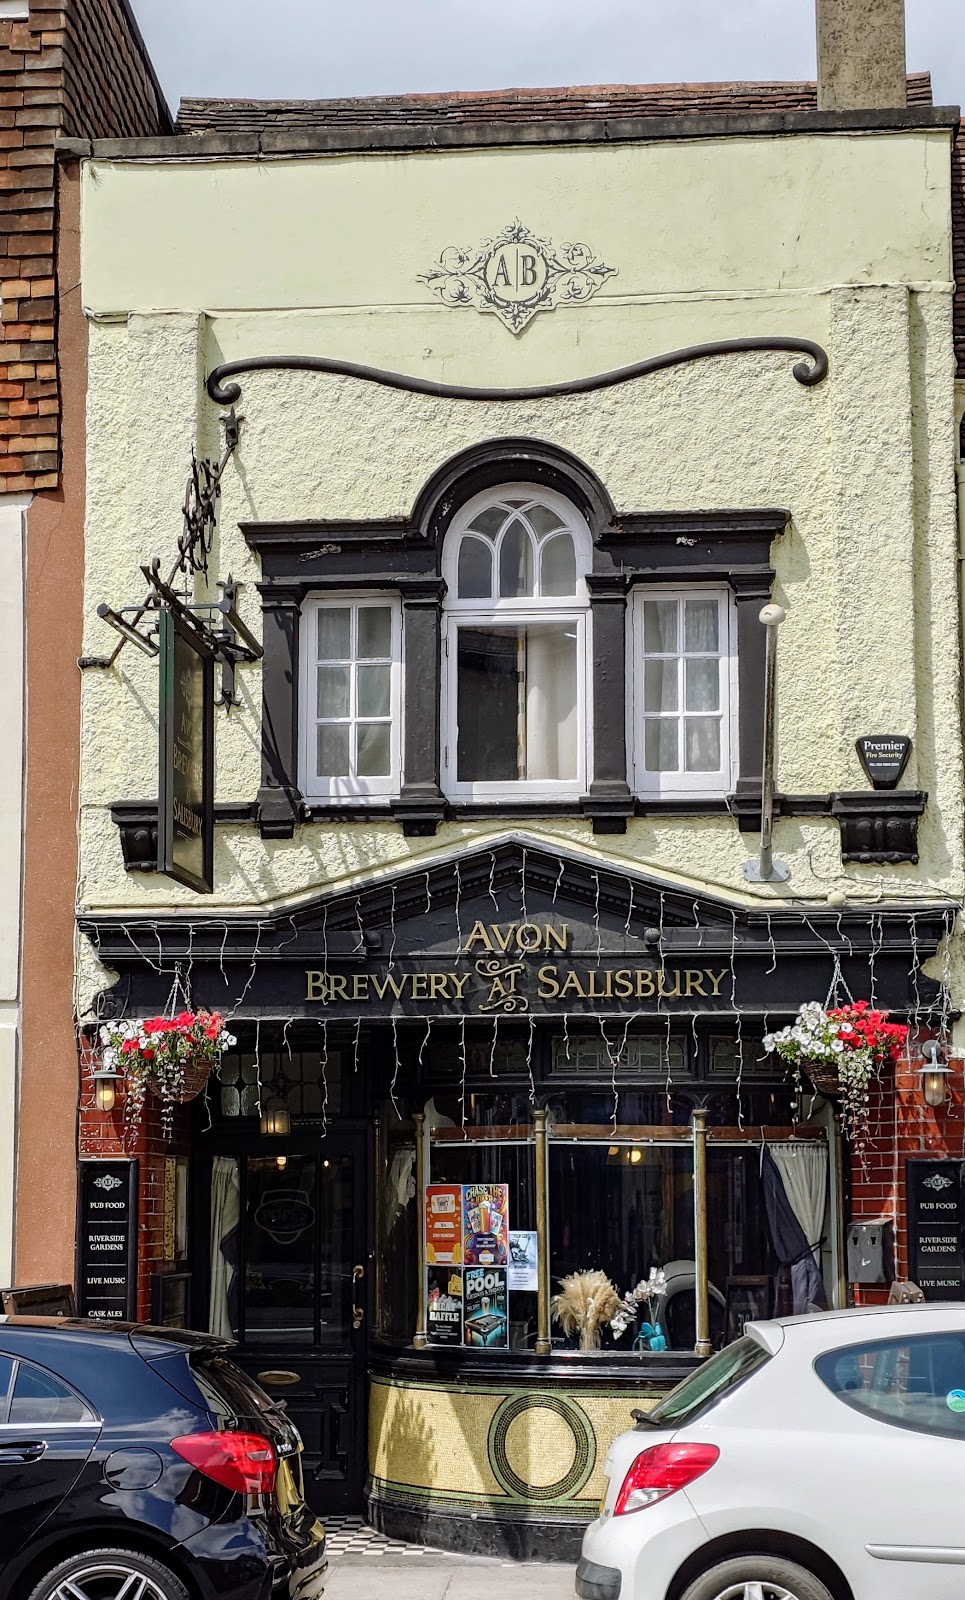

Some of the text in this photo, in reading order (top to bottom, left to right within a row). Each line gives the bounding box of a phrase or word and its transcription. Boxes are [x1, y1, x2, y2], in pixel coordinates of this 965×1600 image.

[864, 740, 905, 751] Premier
[866, 751, 903, 760] Fire Security
[462, 920, 568, 951] AVON
[304, 965, 729, 1002] BREWERY AT SALISBURY
[466, 1185, 489, 1200] CHASE
[920, 1202, 957, 1210] PUB FOOD
[919, 1236, 958, 1244] RIVERSIDE
[90, 1243, 124, 1251] GARDENS
[921, 1245, 956, 1253] GARDENS
[466, 1268, 485, 1280] FREE
[466, 1272, 505, 1295] POOL
[919, 1279, 960, 1287] LIVE MUSIC
[88, 1310, 123, 1318] CASK ALES
